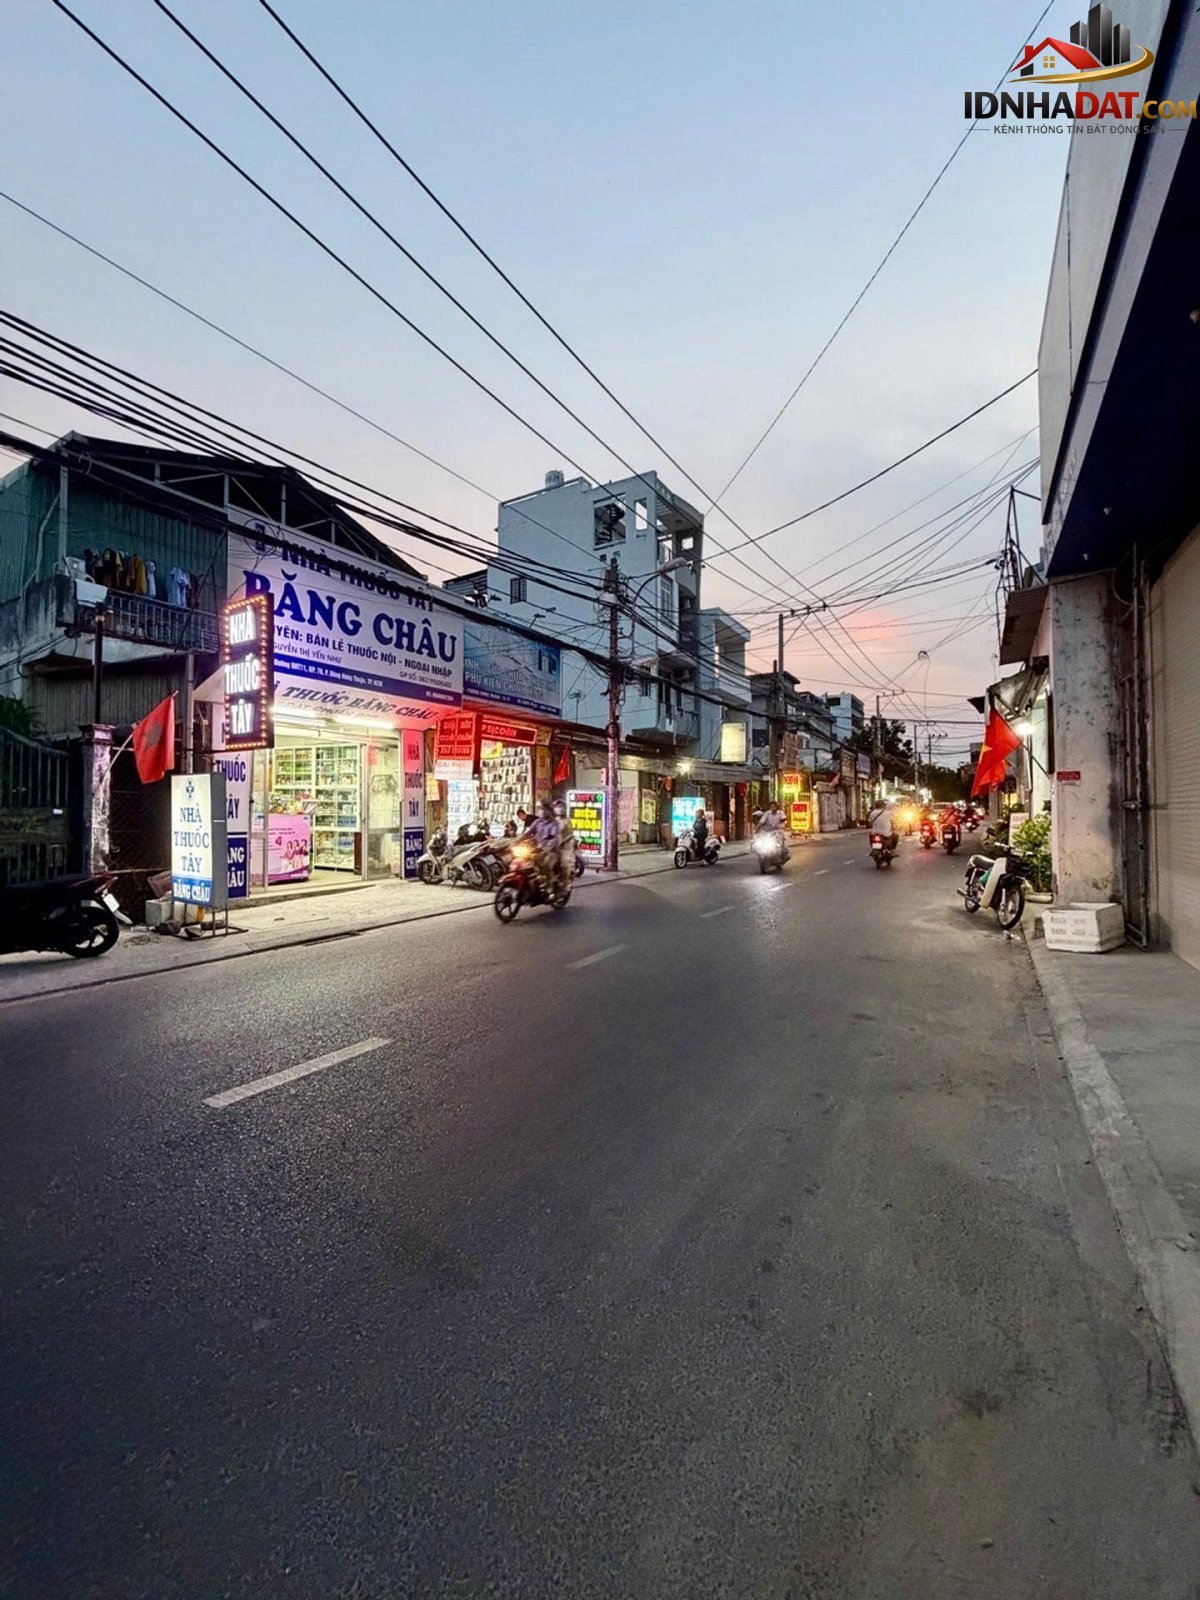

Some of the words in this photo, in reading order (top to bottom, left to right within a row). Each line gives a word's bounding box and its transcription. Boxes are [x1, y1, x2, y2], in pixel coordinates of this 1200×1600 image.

[229, 605, 257, 645] NHÀ
[274, 624, 303, 642] YÊN:
[347, 643, 379, 660] THUỐC
[380, 652, 397, 665] NỘI
[404, 658, 430, 673] NGOẠI
[431, 664, 453, 679] NHẬP
[373, 617, 458, 663] CHÂU
[224, 653, 261, 695] THUỐC
[282, 686, 349, 704] THUỐC
[346, 693, 398, 713] BĂNG
[397, 703, 440, 720] CHÂU
[231, 698, 255, 735] TÂY
[404, 767, 423, 789] THUỐC
[180, 803, 202, 823] NHÀ
[226, 793, 240, 819] ÂY
[408, 797, 419, 817] TÂY
[174, 825, 210, 849] THUỐC
[181, 852, 203, 873] TÂY
[173, 880, 191, 900] BĂNG
[191, 881, 211, 902] CHÂU
[227, 871, 245, 888] ÂU
